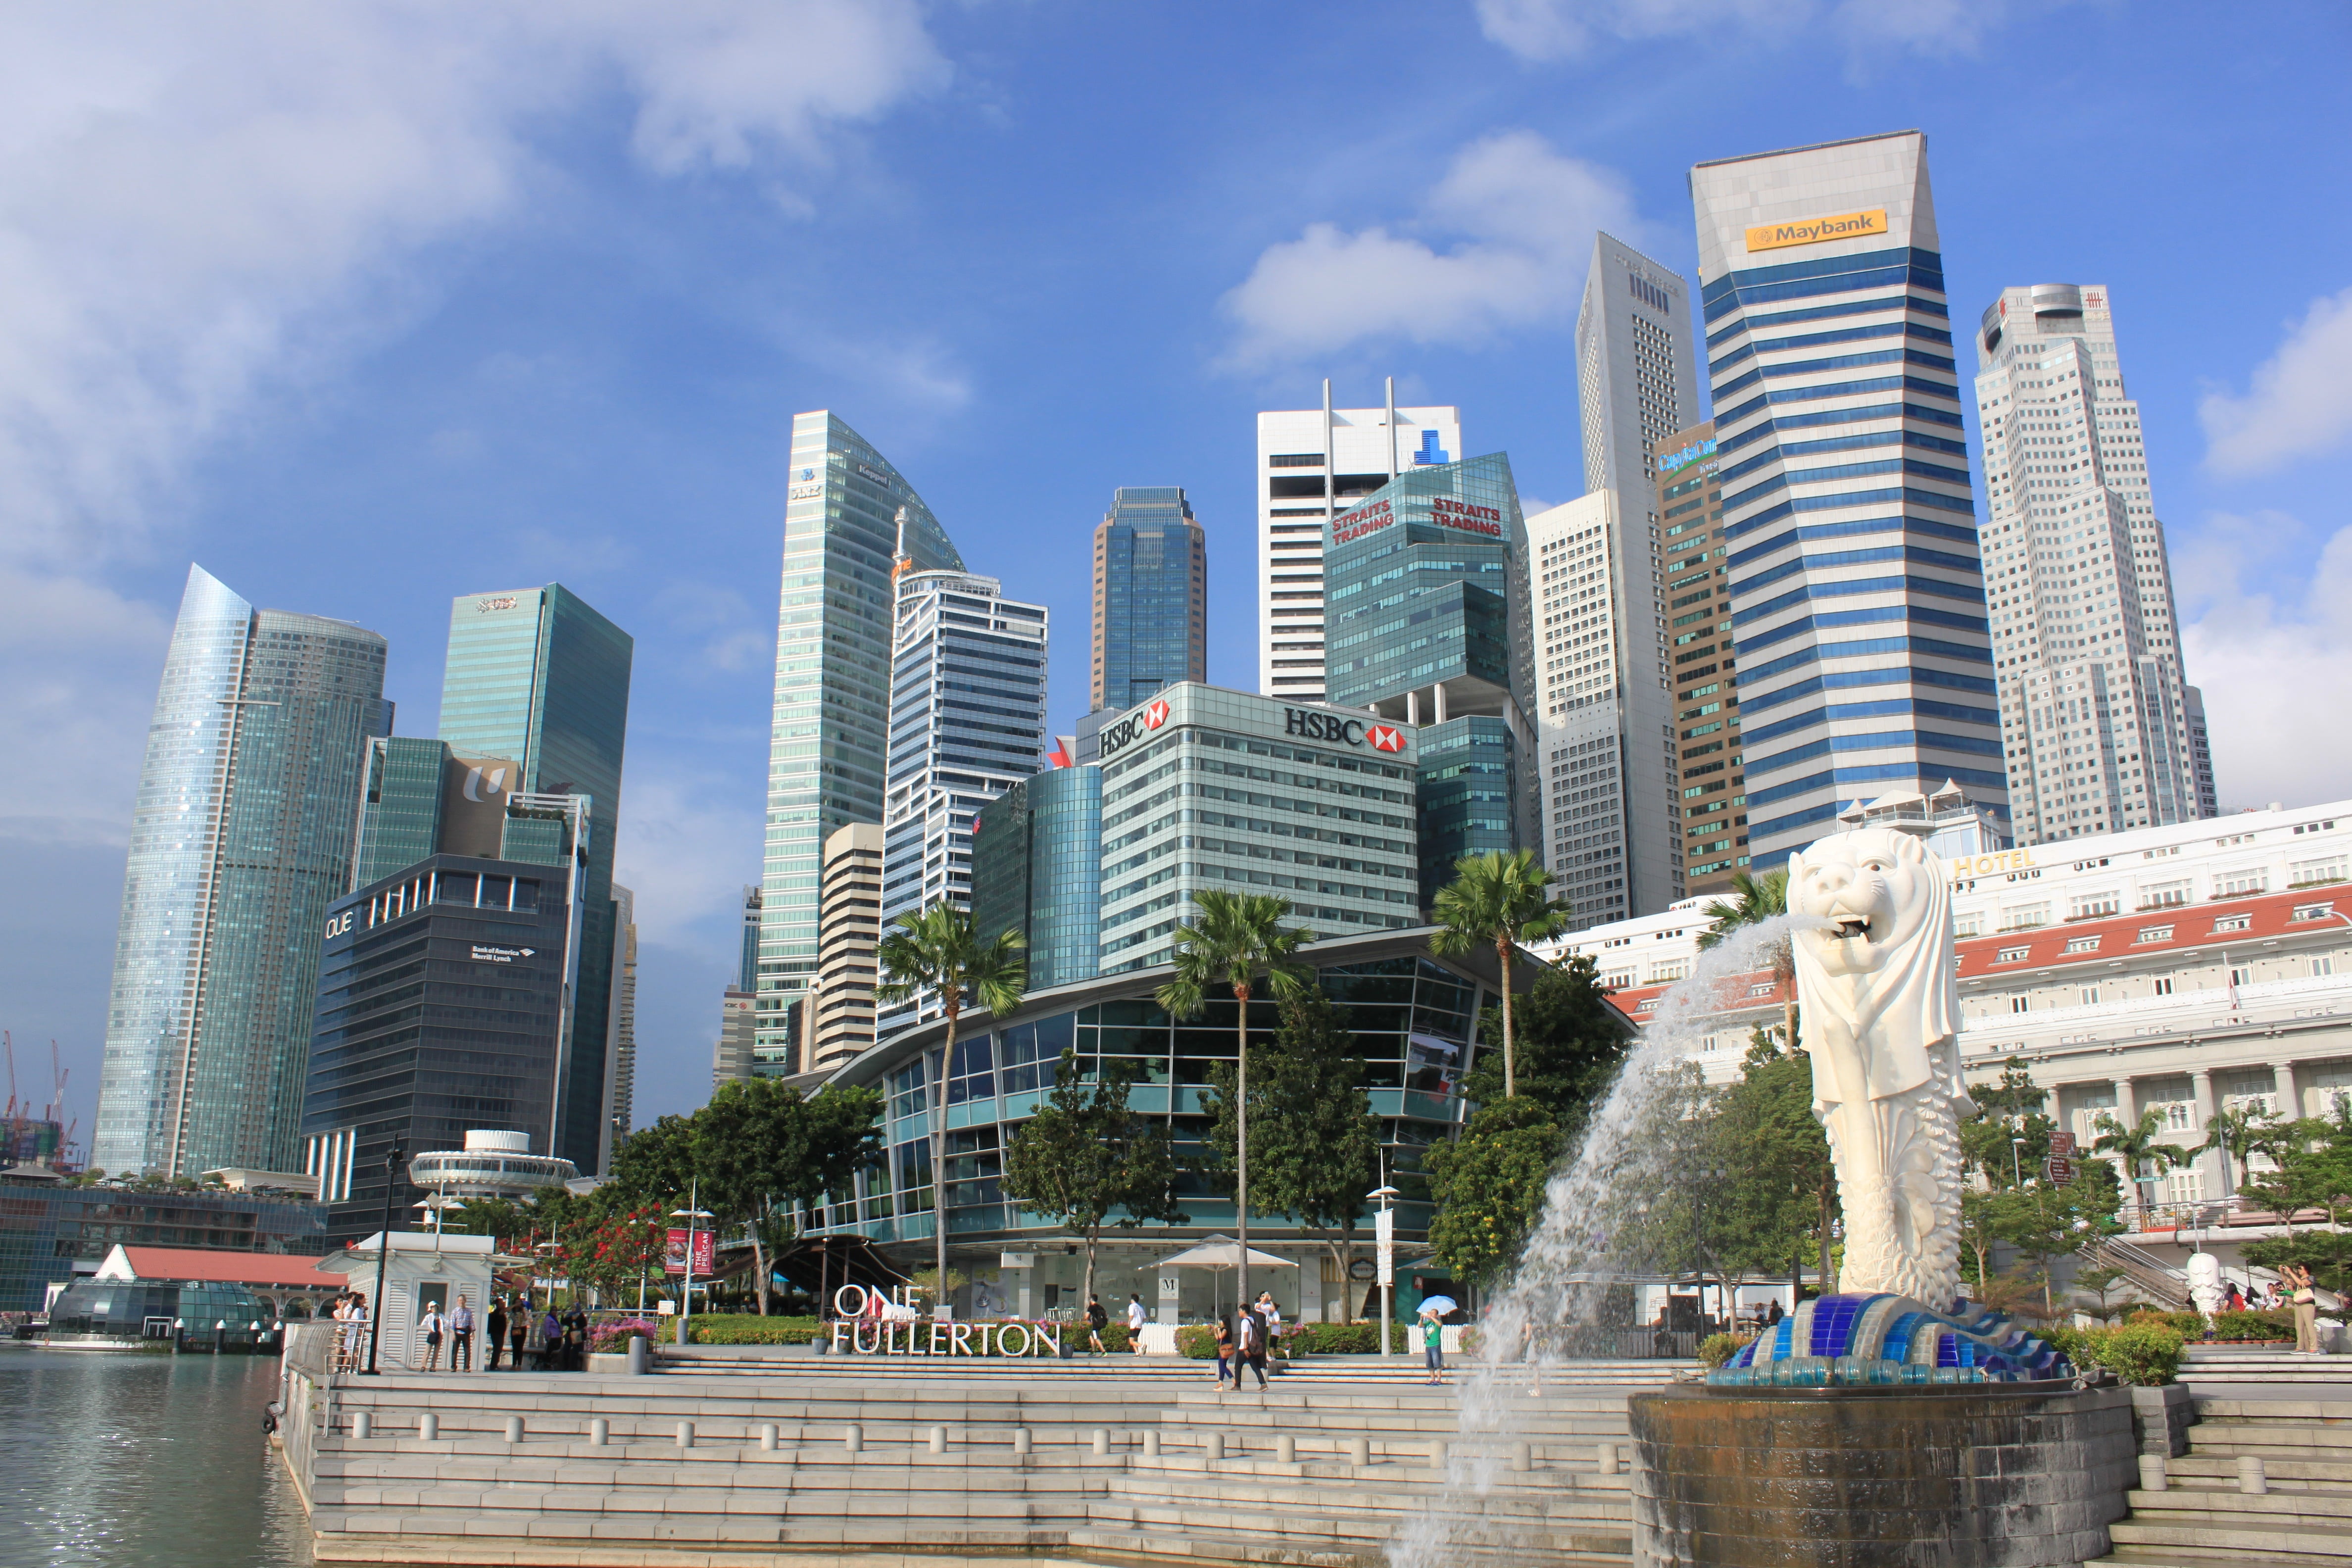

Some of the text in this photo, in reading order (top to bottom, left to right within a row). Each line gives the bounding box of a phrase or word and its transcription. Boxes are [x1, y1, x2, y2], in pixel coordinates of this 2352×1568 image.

[1776, 215, 1873, 241] Maybank
[859, 464, 887, 485] Keppel
[792, 486, 821, 499] ANZ
[1333, 499, 1390, 531] STRAITS
[1430, 512, 1501, 537] TRADING
[1434, 498, 1500, 521] STRAITS
[1333, 513, 1394, 545] TRADING
[1099, 711, 1143, 759] HSBC
[1284, 707, 1363, 746] HSBC
[1954, 848, 2036, 878] HOTEL
[326, 911, 353, 939] OUE
[834, 1284, 921, 1317] ONE
[832, 1322, 1060, 1356] FULLERTON
